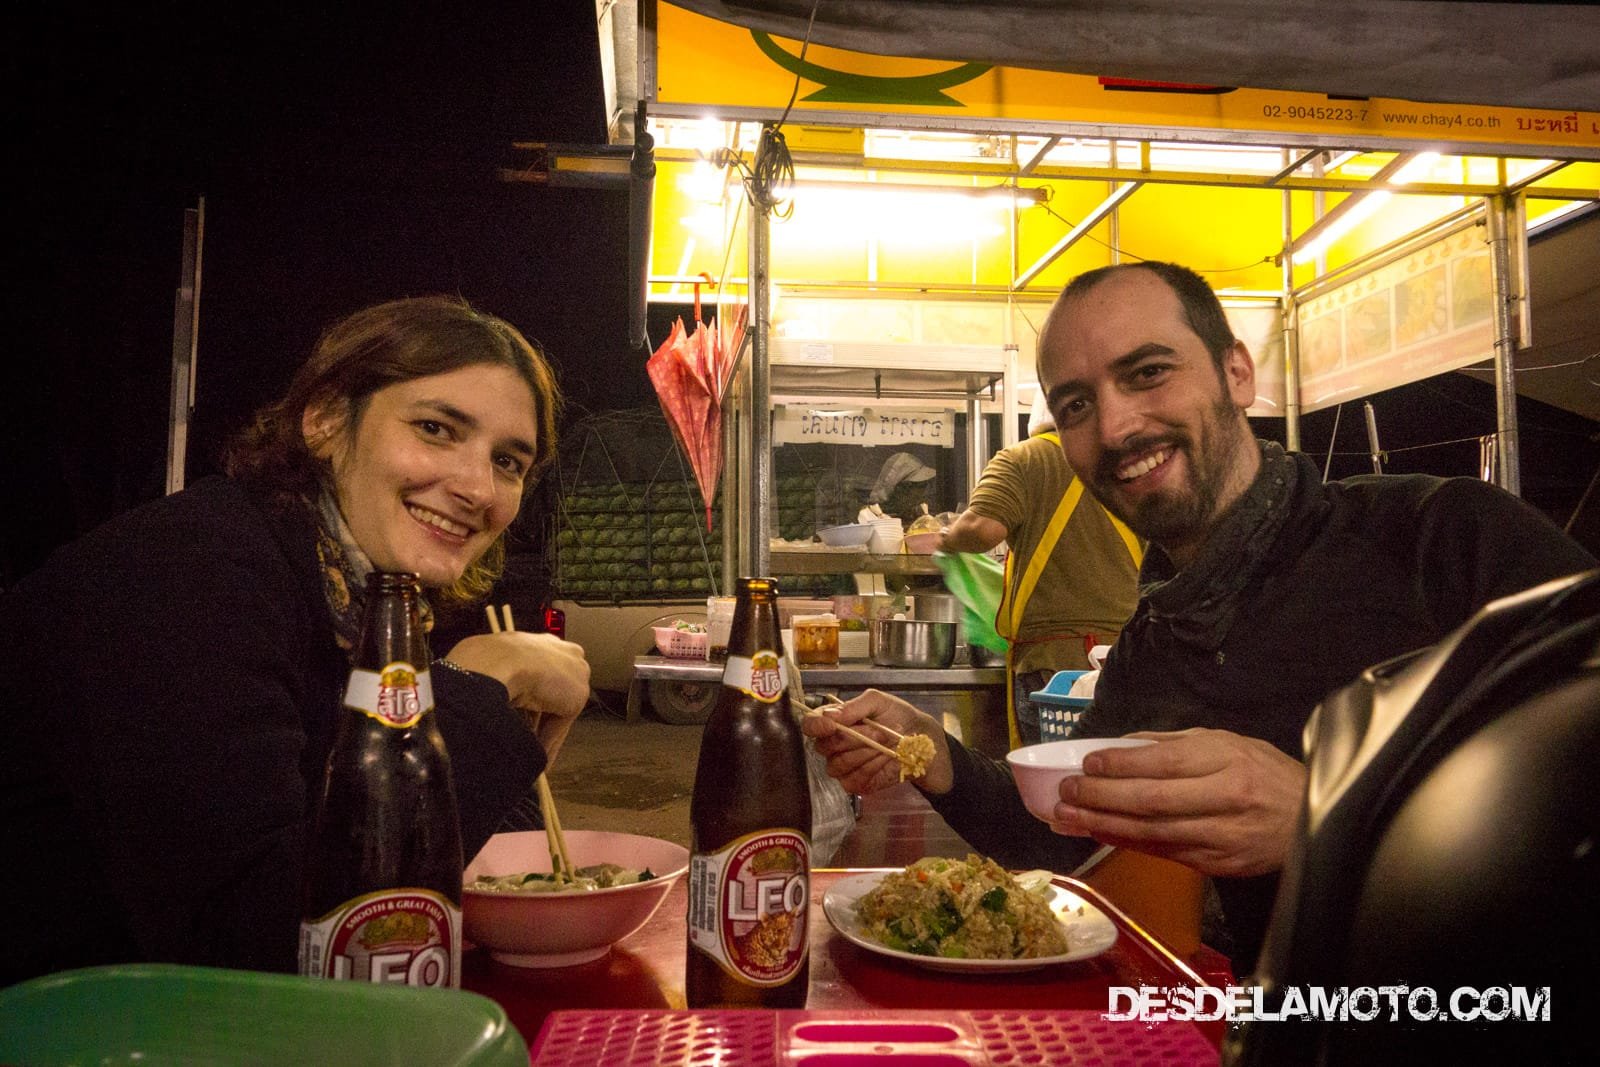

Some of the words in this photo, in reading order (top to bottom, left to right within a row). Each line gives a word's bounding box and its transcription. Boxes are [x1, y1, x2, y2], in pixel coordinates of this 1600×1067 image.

[1262, 104, 1368, 121] 02-9045223-7
[1383, 111, 1501, 129] www.chay4.co.th
[1516, 112, 1579, 133] บะหมี่
[737, 839, 768, 860] SMOOTH
[728, 873, 809, 923] LEO
[346, 902, 387, 929] SMOOTH
[387, 901, 395, 911] &
[396, 900, 425, 910] GREAT
